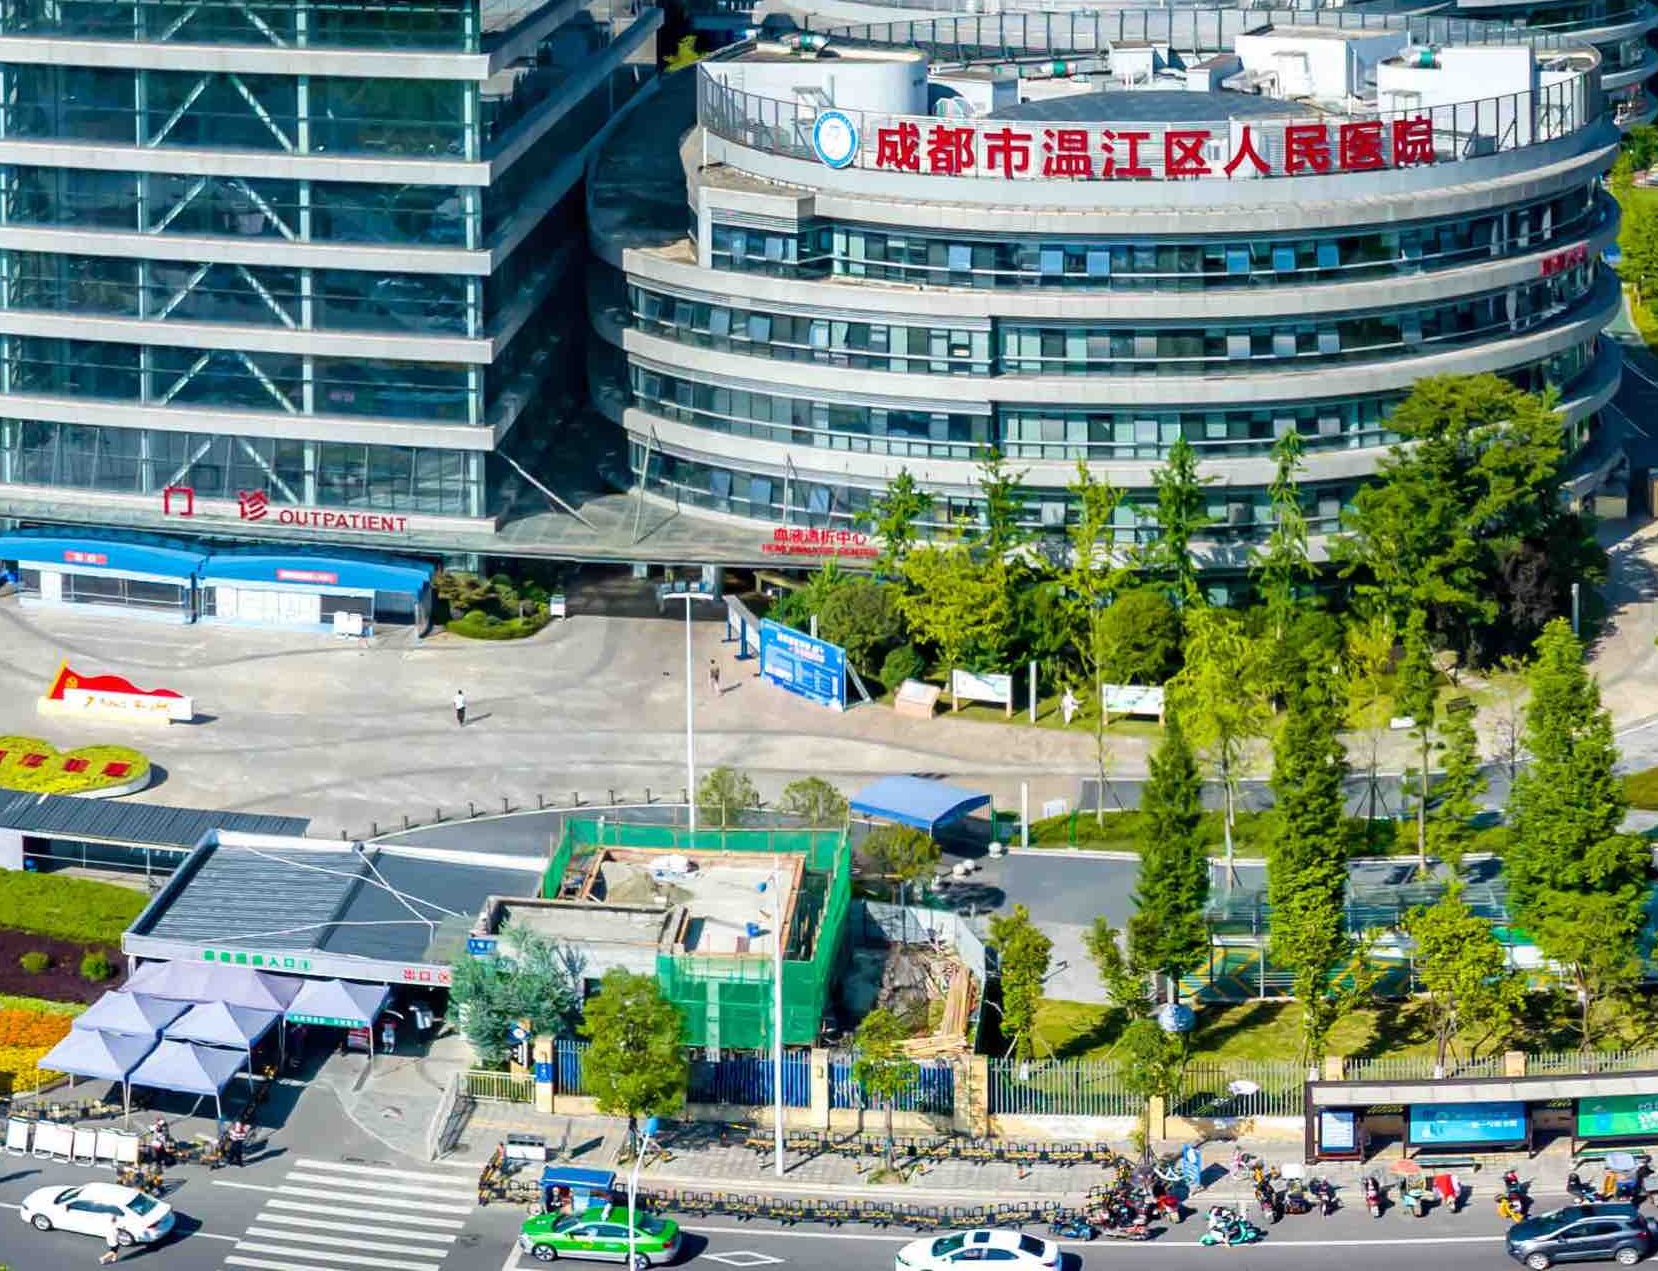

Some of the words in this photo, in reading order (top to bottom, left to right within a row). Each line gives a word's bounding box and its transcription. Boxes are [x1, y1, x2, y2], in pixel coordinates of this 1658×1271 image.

[875, 114, 1434, 180] 成都市温江区人民医院
[163, 486, 270, 521] 门诊
[278, 509, 407, 533] OUTPATIENT
